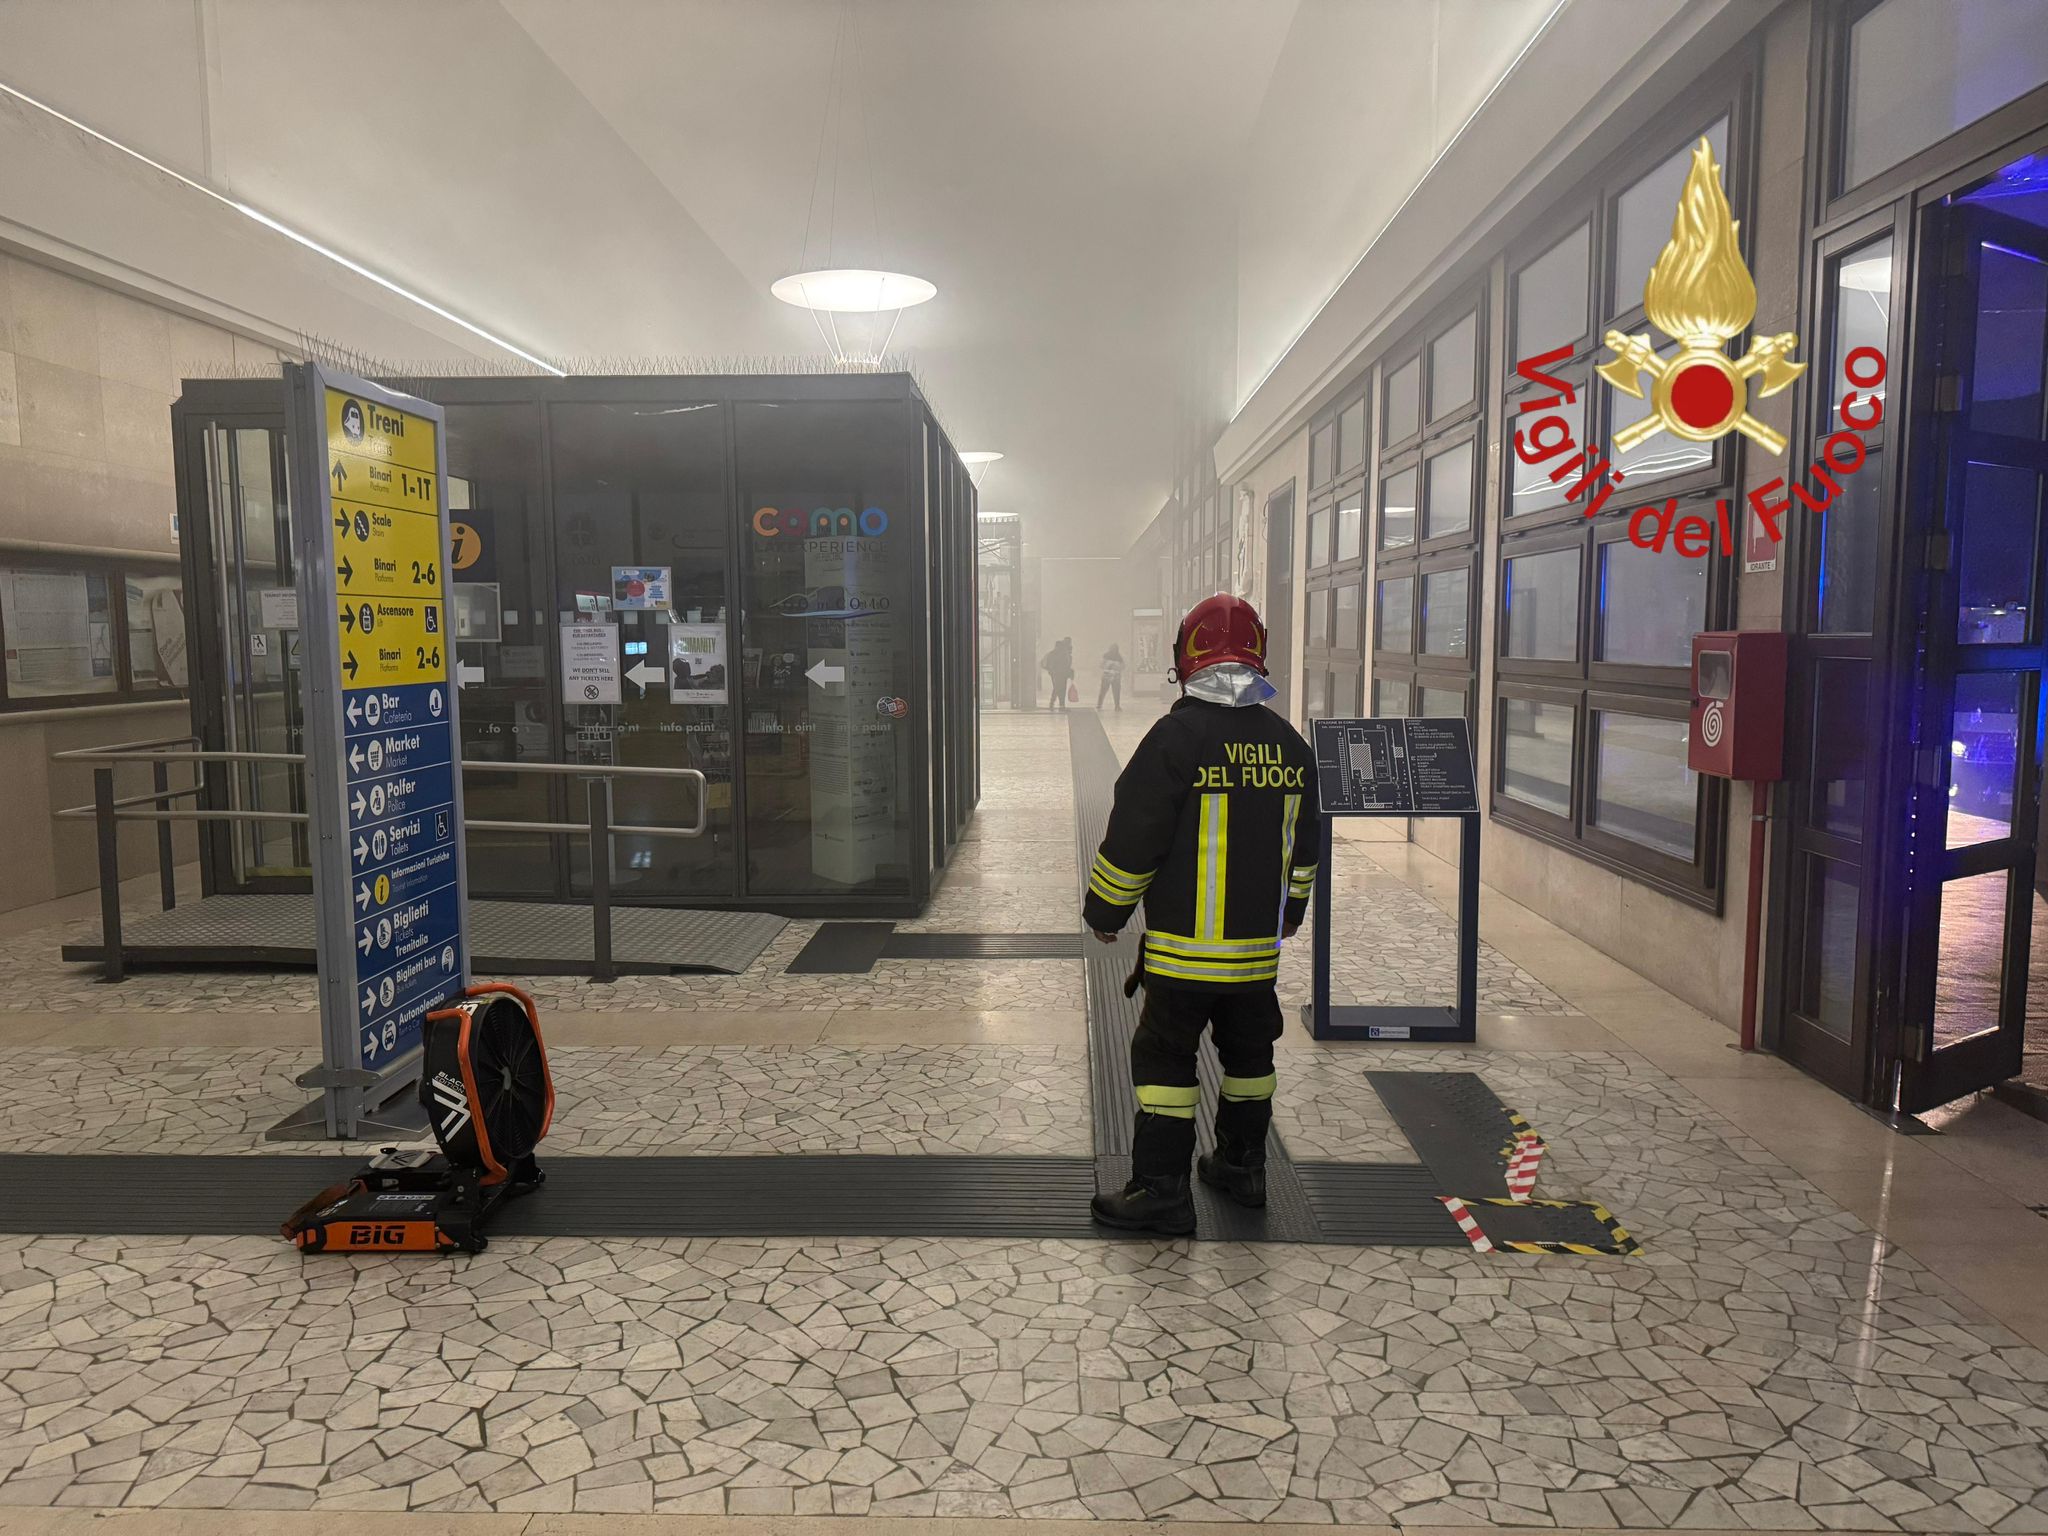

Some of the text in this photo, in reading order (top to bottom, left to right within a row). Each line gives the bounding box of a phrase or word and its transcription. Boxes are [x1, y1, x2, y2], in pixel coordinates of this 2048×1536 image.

[368, 404, 404, 437] Treni
[369, 466, 431, 500] Binari 1-1T
[372, 512, 392, 528] Scale
[374, 558, 435, 585] Binari 2-6
[1750, 562, 1772, 571] IDRANTE
[377, 603, 414, 617] Ascensore
[379, 646, 440, 669] Binari 2-6
[382, 693, 400, 710] Bar
[383, 710, 412, 724] Cafeteria
[660, 722, 715, 735] info point
[385, 734, 420, 753] Market
[386, 754, 408, 769] Market
[1224, 743, 1282, 765] VIGILI
[387, 778, 416, 798] Polfer
[387, 799, 406, 813] Police
[389, 818, 421, 842] Servizi
[390, 842, 409, 857] Toilets
[391, 851, 450, 879] Informazioni Turistiche
[393, 900, 429, 930] Biglietti
[395, 926, 414, 942] Tickets
[395, 934, 429, 958] Trenitalia
[396, 962, 423, 983] Biglietti
[434, 1075, 465, 1093] EDITION
[350, 1225, 406, 1244] BIG
